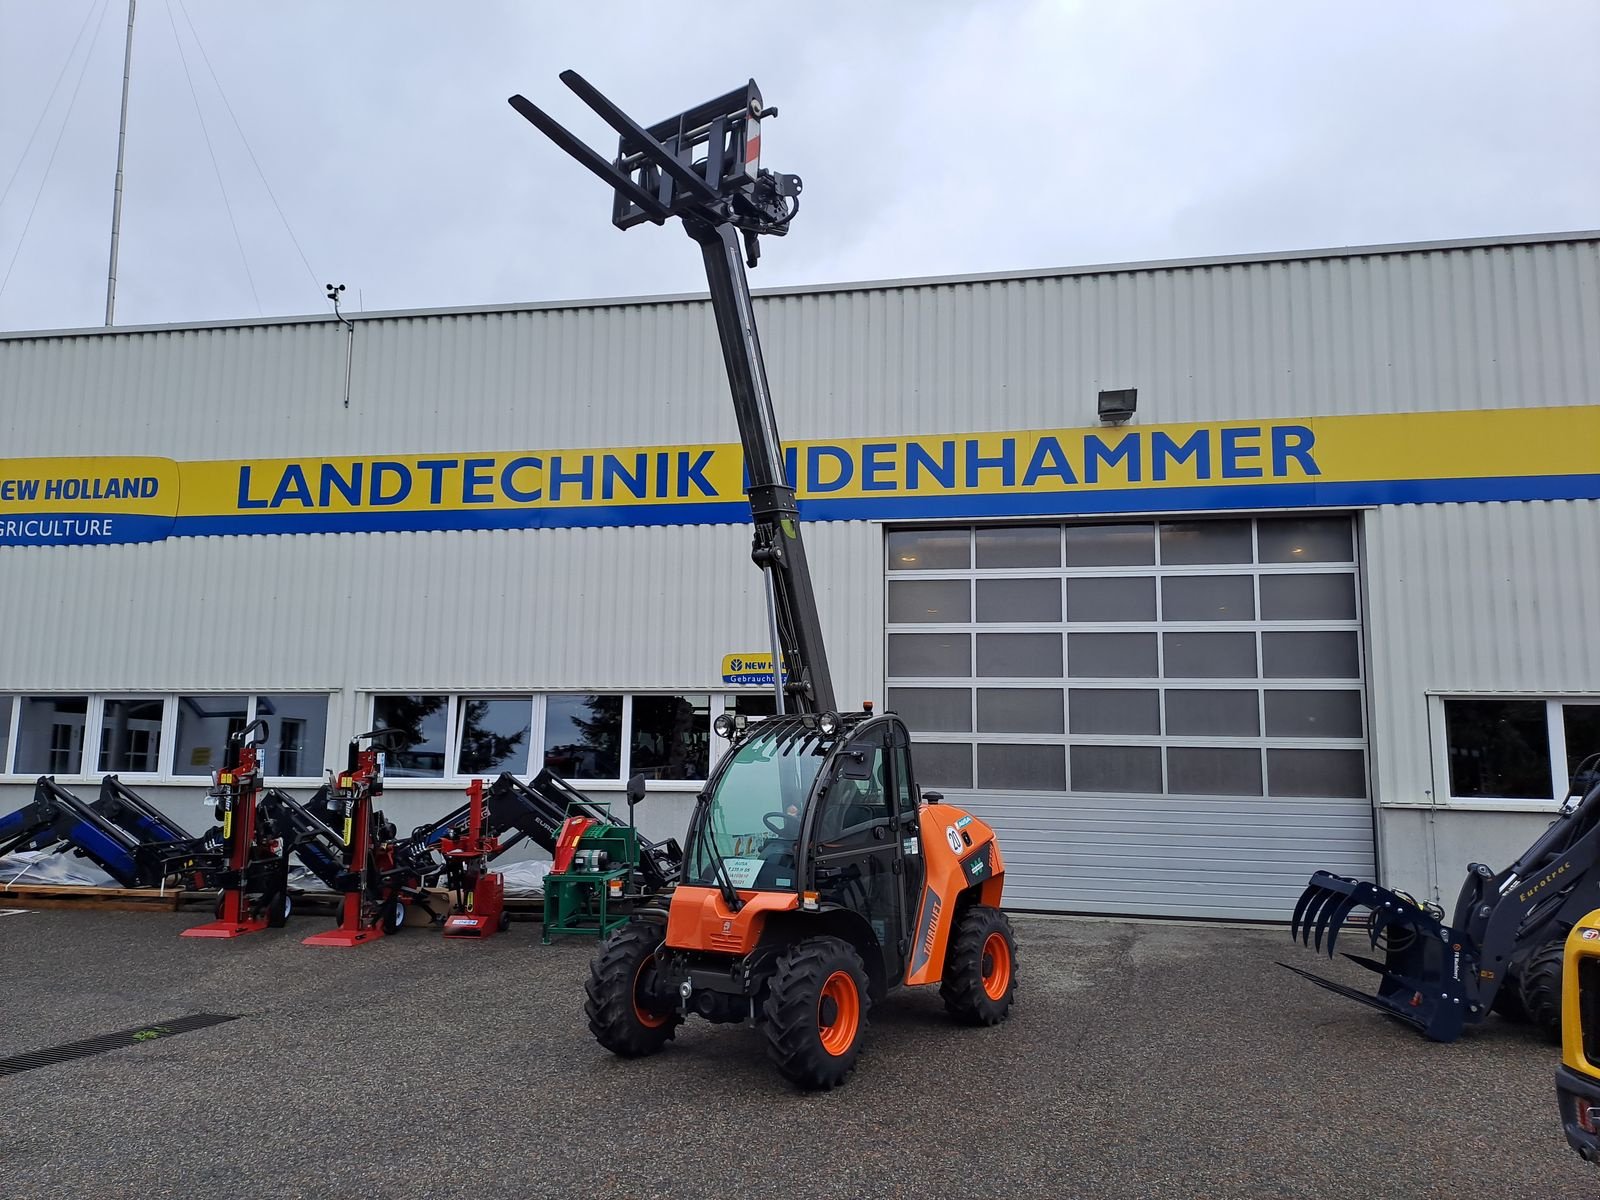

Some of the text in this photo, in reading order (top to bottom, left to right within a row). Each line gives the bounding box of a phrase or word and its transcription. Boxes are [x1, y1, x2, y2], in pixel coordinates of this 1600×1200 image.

[237, 425, 1321, 508] LANDTECHNIK IDENHAMMER
[0, 477, 158, 501] EW HOLLAND
[744, 661, 766, 670] NEW
[948, 830, 961, 851] 20
[1519, 862, 1571, 902] Eurotrac
